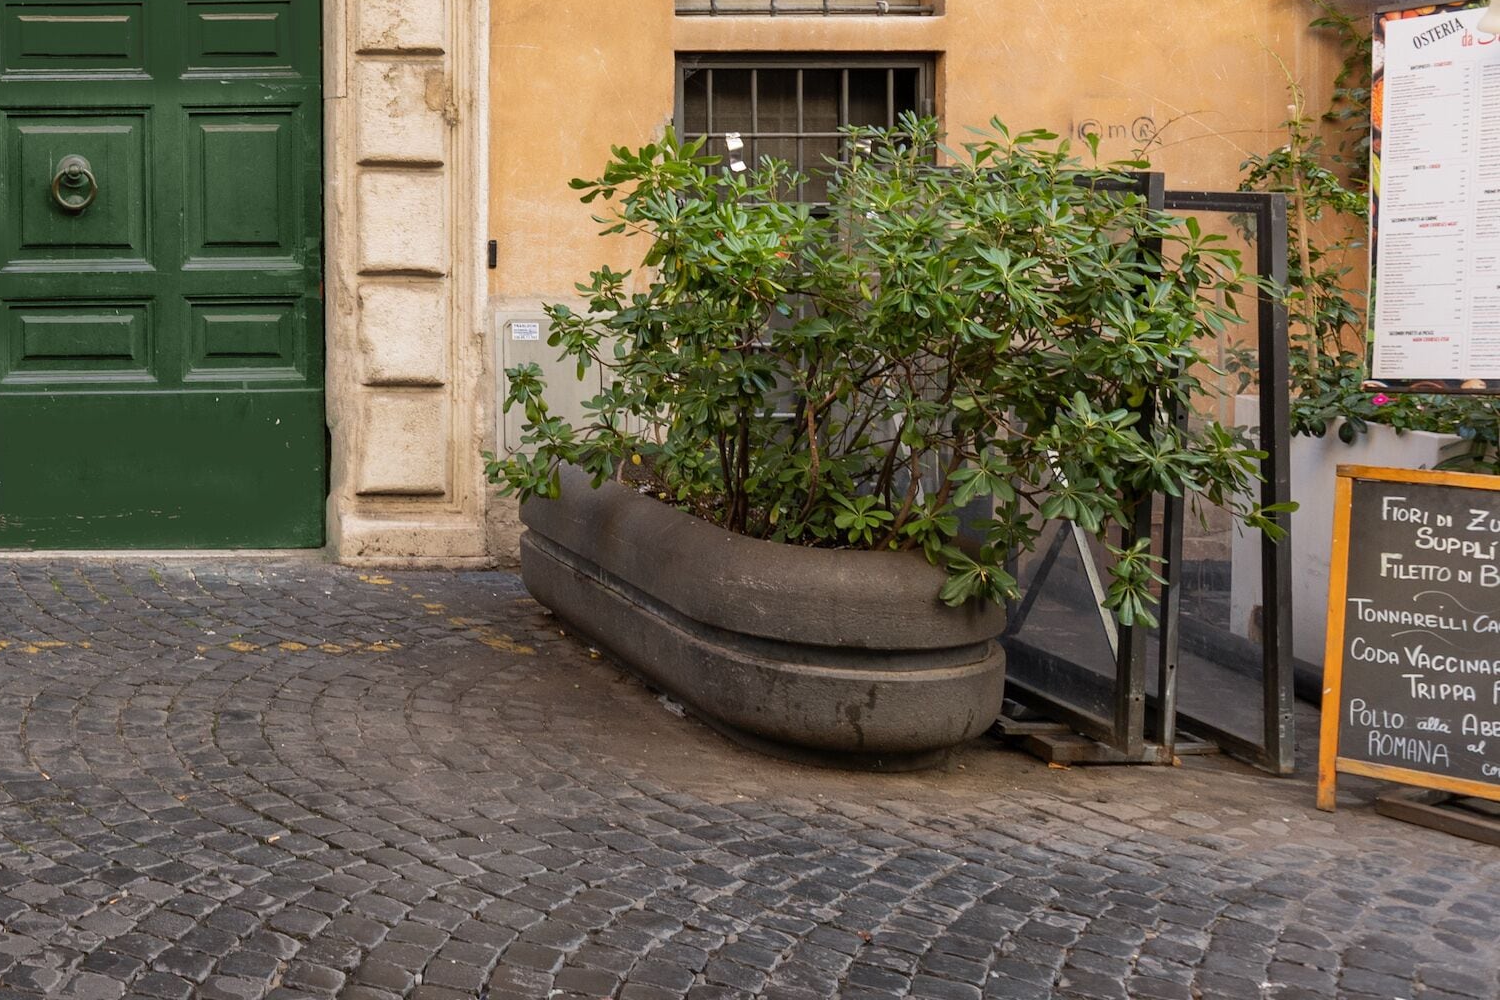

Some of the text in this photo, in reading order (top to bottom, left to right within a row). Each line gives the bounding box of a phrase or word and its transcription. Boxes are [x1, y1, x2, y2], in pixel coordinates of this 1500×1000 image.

[1412, 18, 1464, 50] OSTERIA
[1462, 29, 1473, 47] da
[1382, 496, 1429, 525] FIORI
[1437, 514, 1452, 527] DI
[1380, 552, 1451, 581] FILETTO
[1458, 570, 1472, 583] DI
[1348, 598, 1500, 633] TONNARELLI CA
[1351, 637, 1399, 665] CODA
[1402, 674, 1476, 701] TRIPPA
[1350, 698, 1404, 729] POLLO
[1417, 717, 1451, 734] alla
[1368, 730, 1486, 768] ROMANA al
